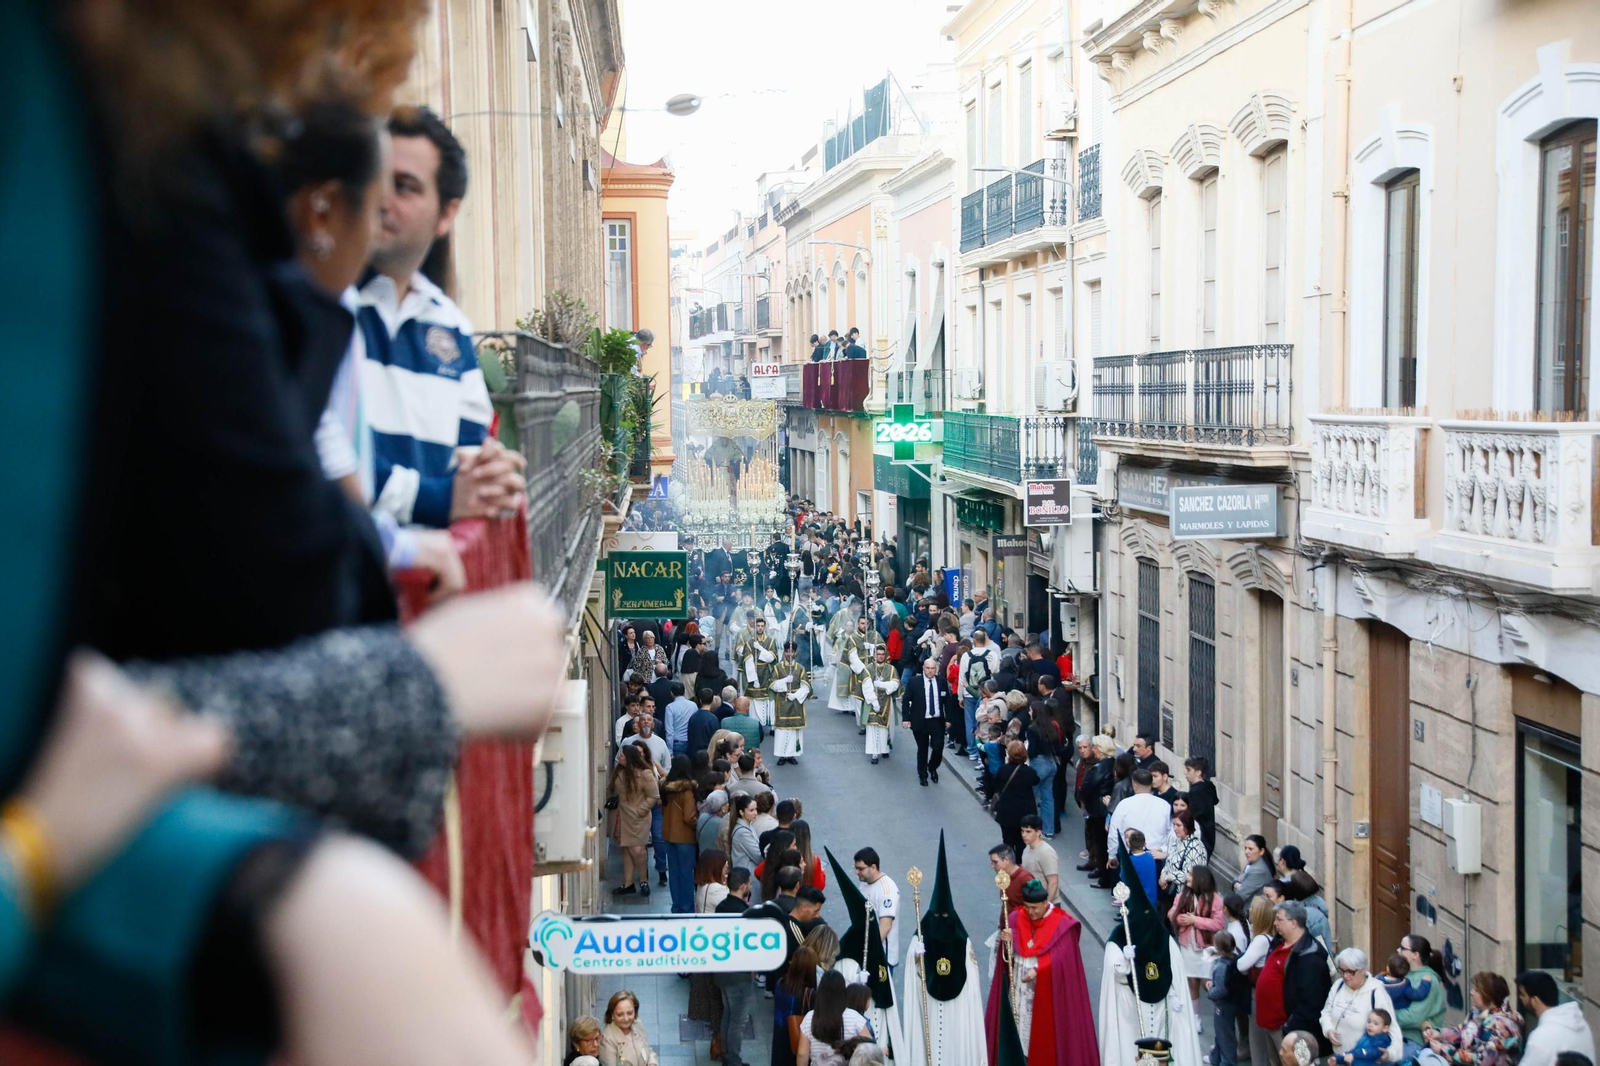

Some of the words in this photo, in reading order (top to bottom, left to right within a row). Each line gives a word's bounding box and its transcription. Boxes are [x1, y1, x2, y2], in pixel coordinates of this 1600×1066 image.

[754, 365, 779, 375] ALFA
[1121, 471, 1169, 495] SANCHEZ
[1121, 492, 1163, 506] MARMOLES
[1179, 496, 1214, 513] SANCHEZ
[1217, 494, 1251, 511] CAZORLA
[1179, 521, 1224, 531] MARMOLES
[1227, 521, 1234, 529] Y
[1236, 520, 1270, 529] LAPIDAS
[613, 561, 683, 579] NACAR
[573, 926, 781, 962] Audiológica
[573, 956, 632, 968] Centros
[637, 954, 707, 967] auditivos
